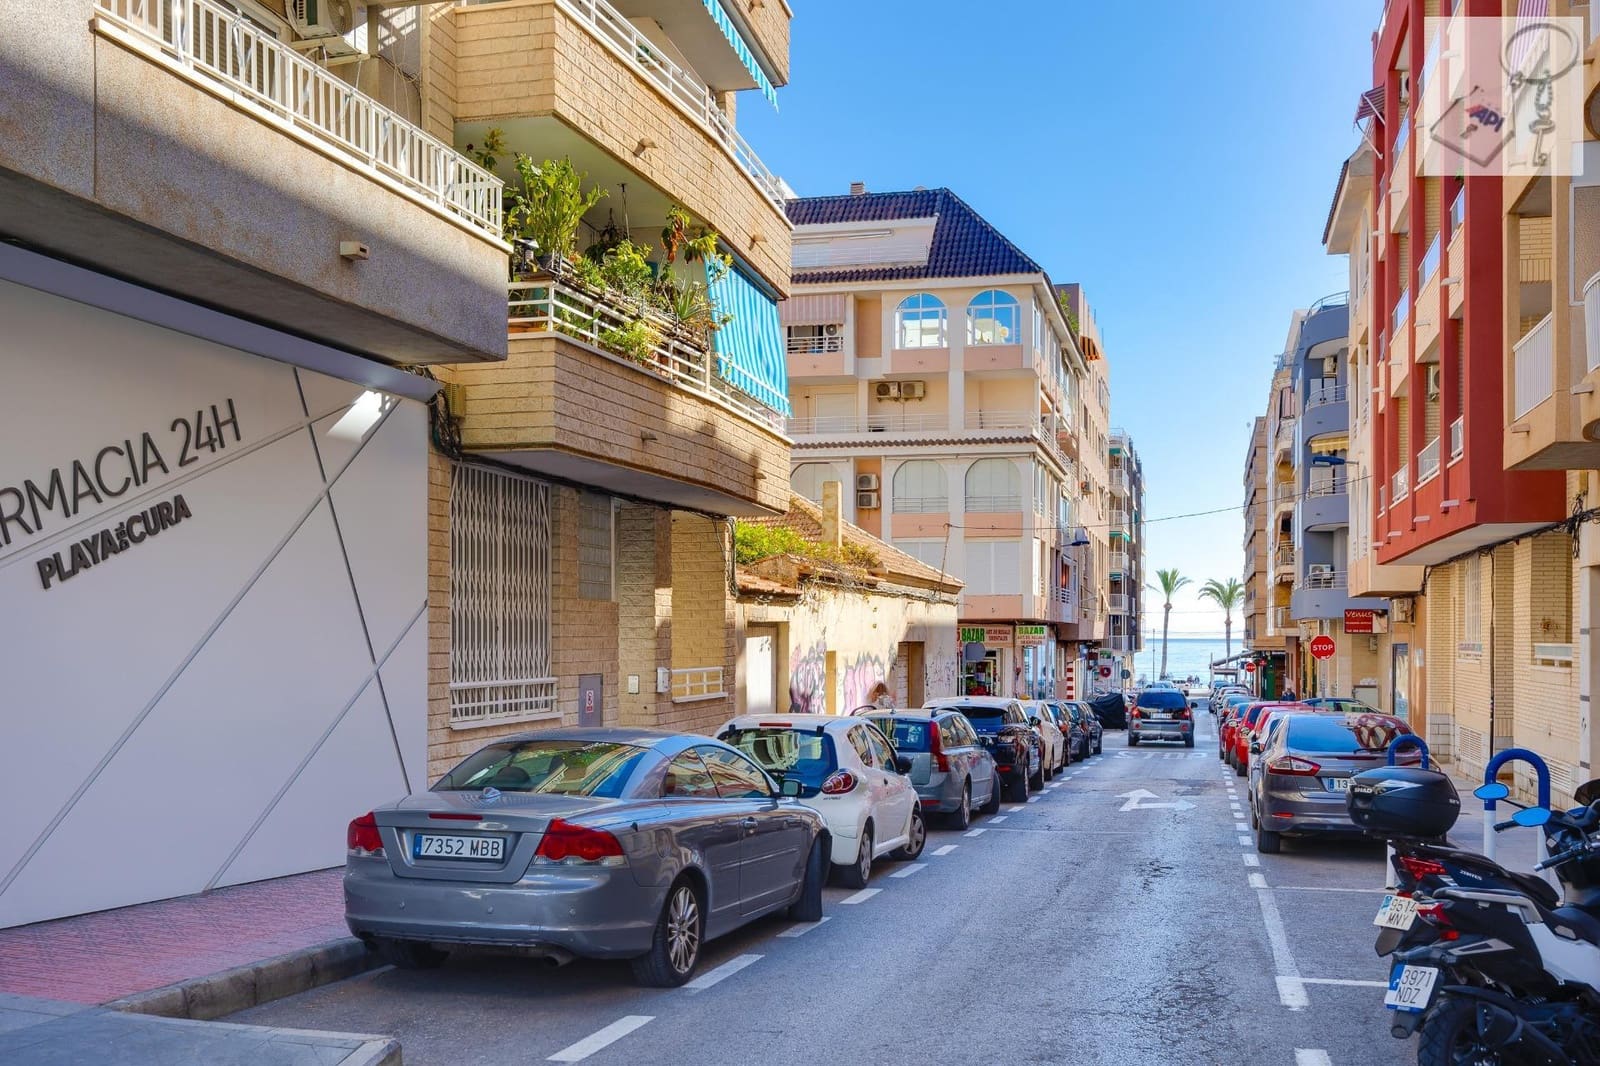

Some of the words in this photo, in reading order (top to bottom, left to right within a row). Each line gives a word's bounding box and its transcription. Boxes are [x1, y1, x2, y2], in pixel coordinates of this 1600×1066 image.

[0, 432, 169, 547] RMACIA
[170, 398, 241, 468] 24H
[36, 528, 120, 590] PLAYA
[126, 494, 193, 544] CURA
[961, 627, 985, 642] BAZAR
[1018, 626, 1044, 634] BAZAR
[1113, 751, 1208, 759] STOP
[1336, 779, 1349, 788] 13
[424, 837, 464, 856] 7352
[469, 839, 500, 858] MBB
[1386, 912, 1409, 927] MNY
[1401, 969, 1433, 988] 3971
[1395, 986, 1421, 1004] NDZ
